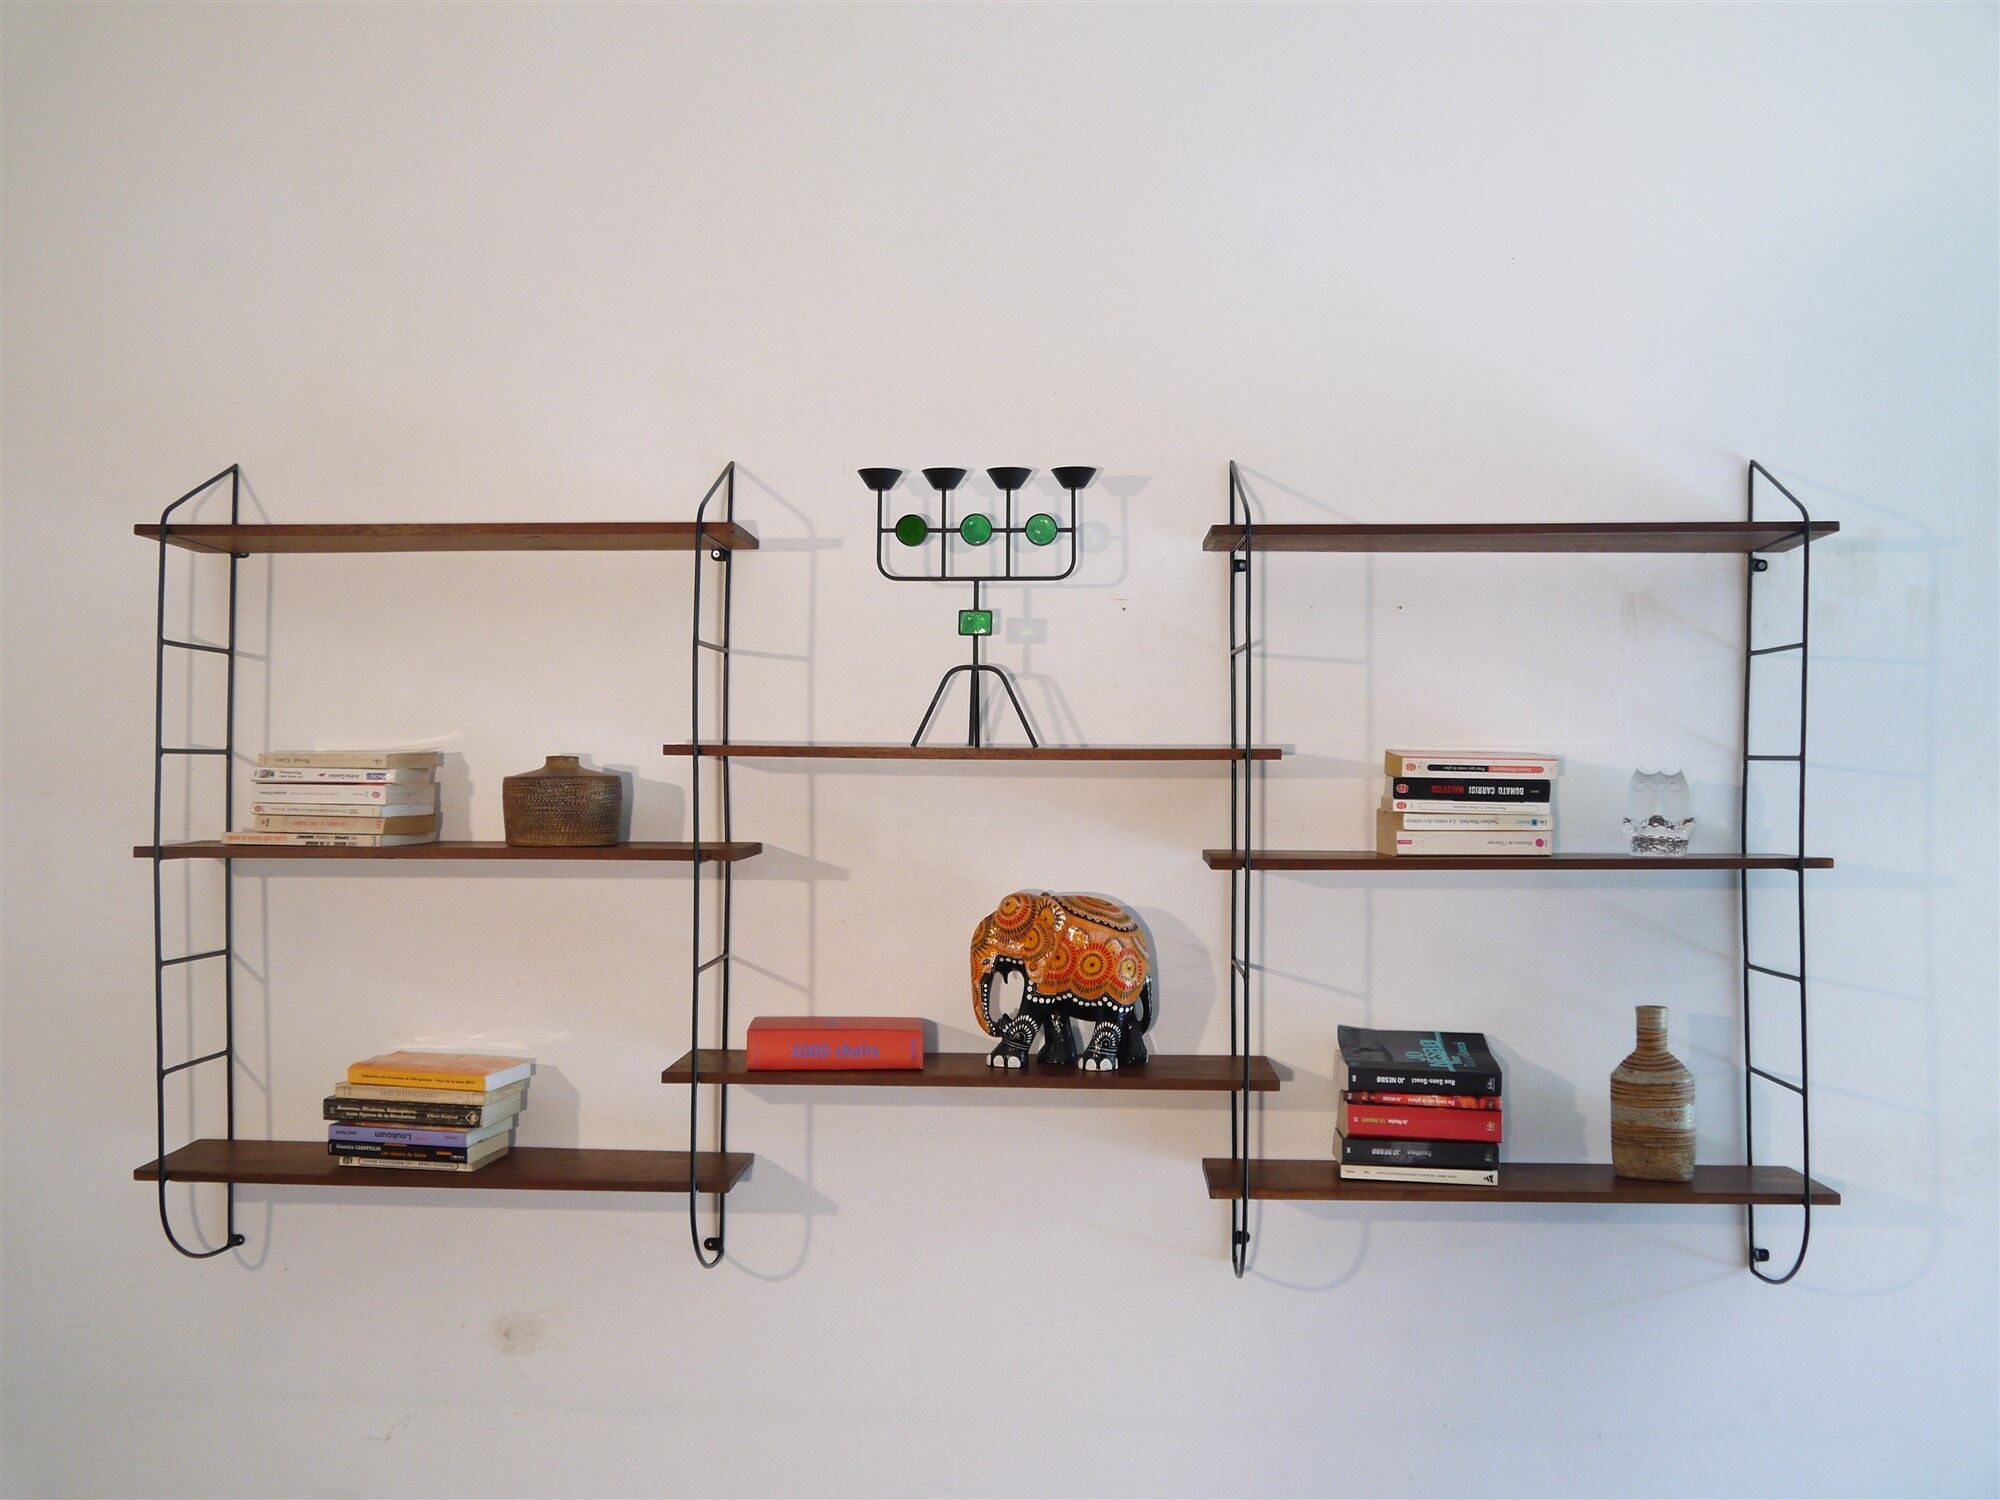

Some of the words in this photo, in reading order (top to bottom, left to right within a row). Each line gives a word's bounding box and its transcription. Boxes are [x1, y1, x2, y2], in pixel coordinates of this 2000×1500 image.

[1469, 786, 1495, 795] CARRISI
[1498, 786, 1524, 796] DONATO
[791, 1042, 831, 1058] 1000
[835, 1042, 880, 1058] chairs
[374, 1132, 411, 1141] Loukoum
